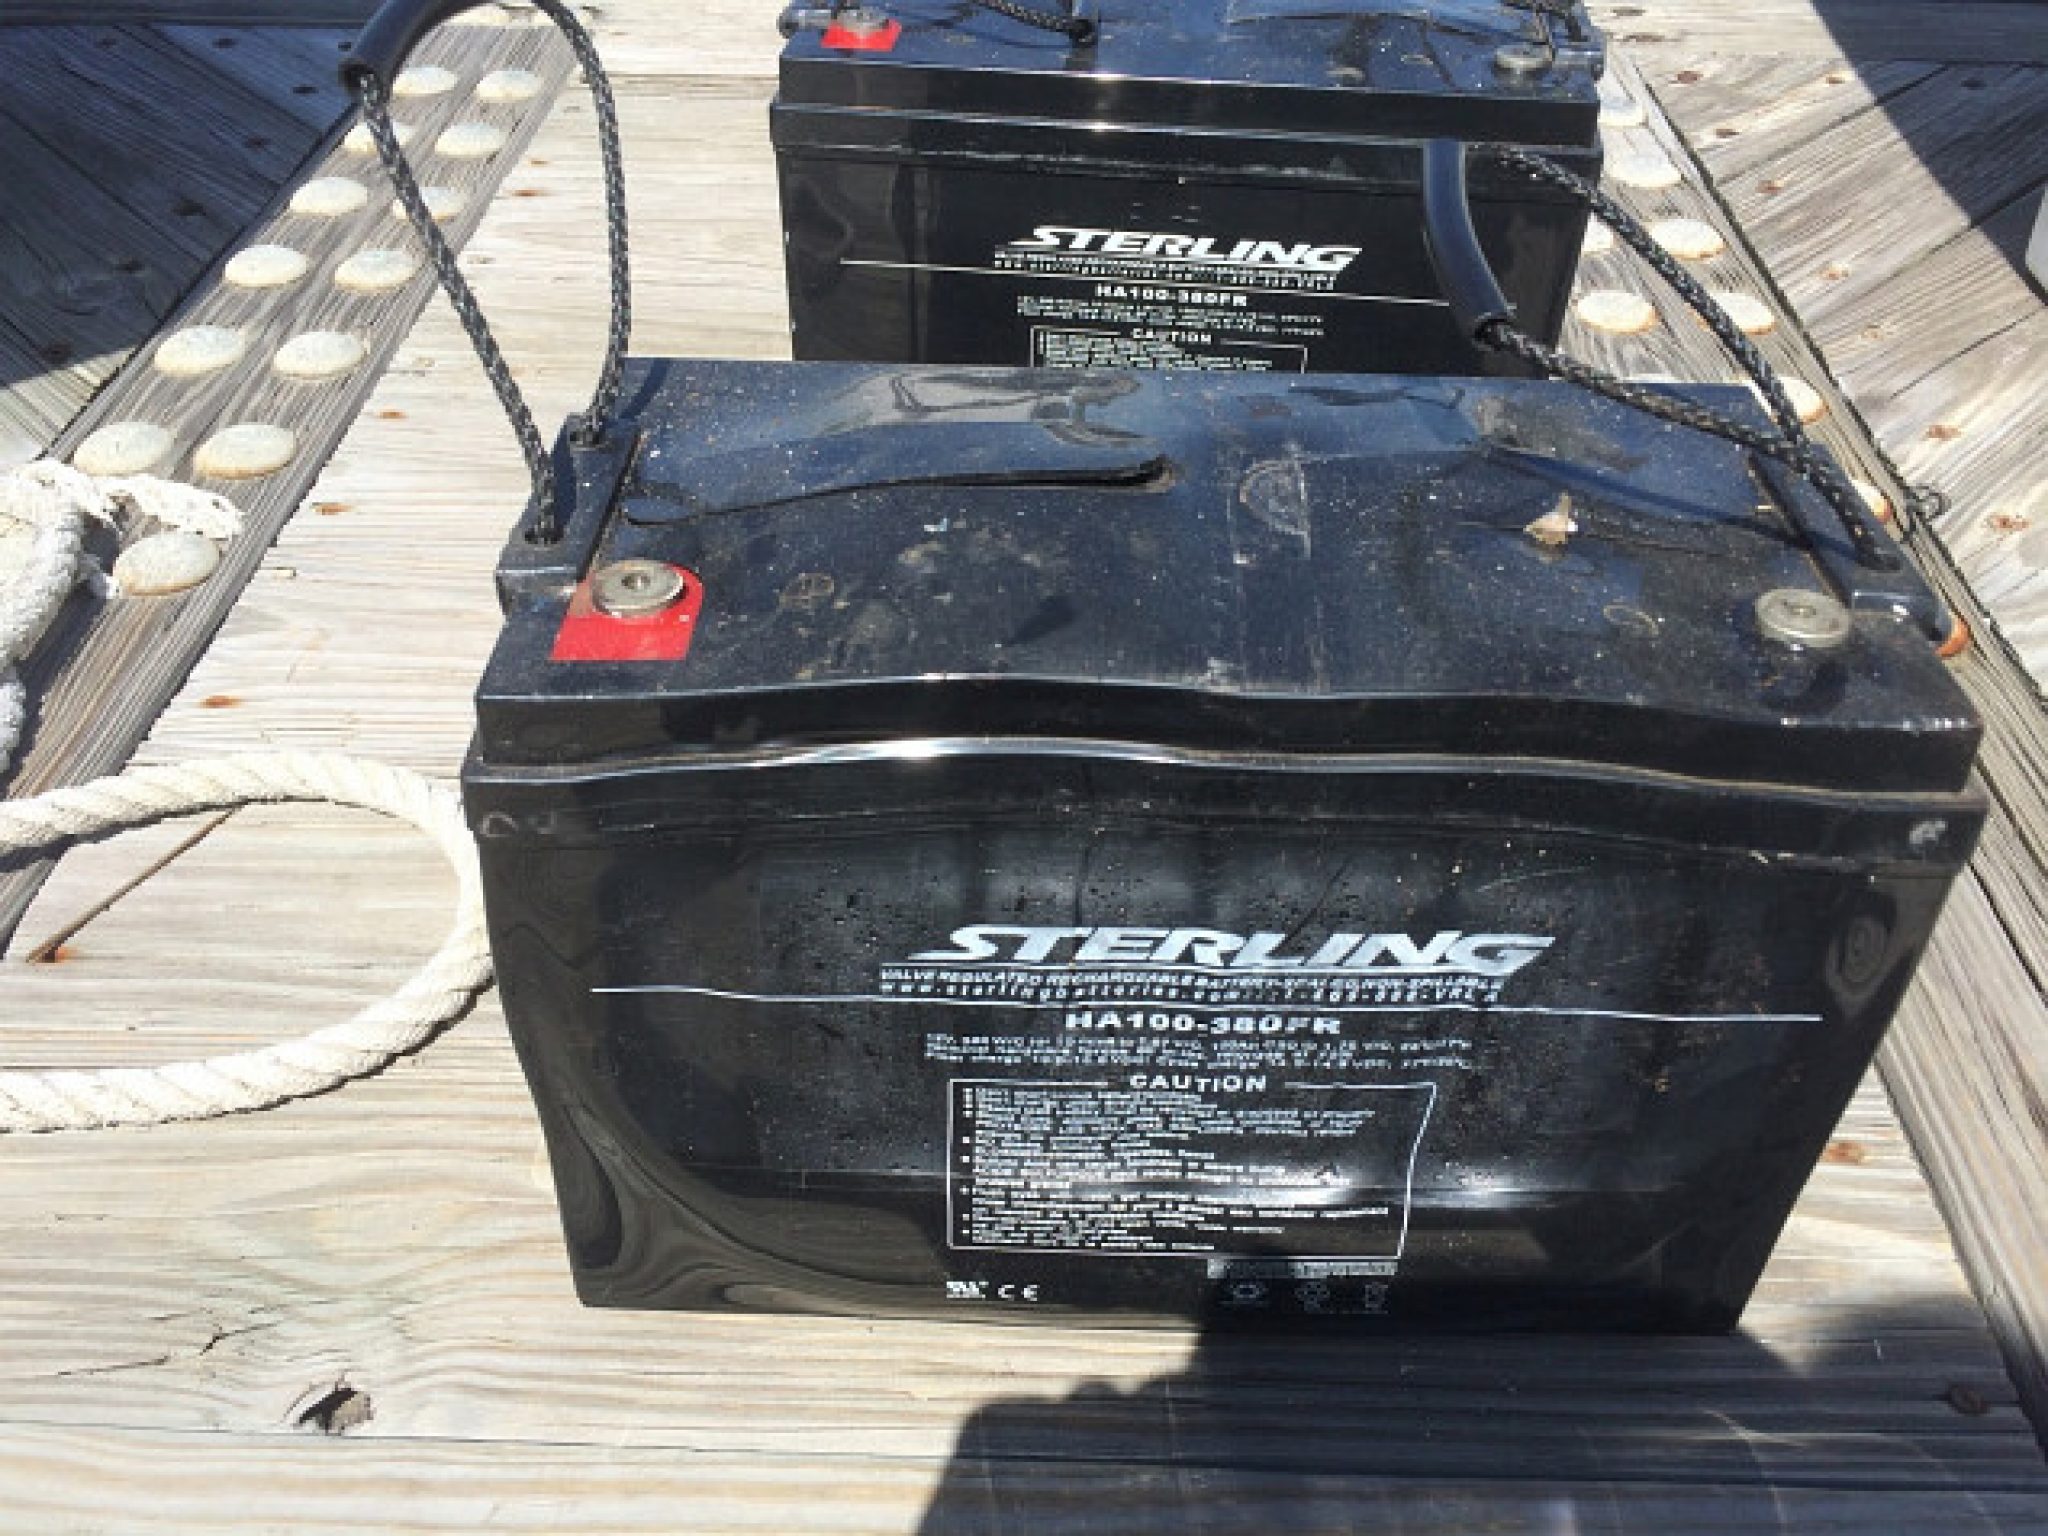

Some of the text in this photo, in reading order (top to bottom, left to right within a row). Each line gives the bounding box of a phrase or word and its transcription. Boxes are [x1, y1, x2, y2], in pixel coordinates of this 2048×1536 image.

[1008, 225, 1363, 272] STERLING
[1131, 328, 1212, 345] CATION
[907, 924, 1557, 977] STERLING
[1064, 1010, 1341, 1036] HA100-380FR
[1129, 1074, 1267, 1093] CAUTION
